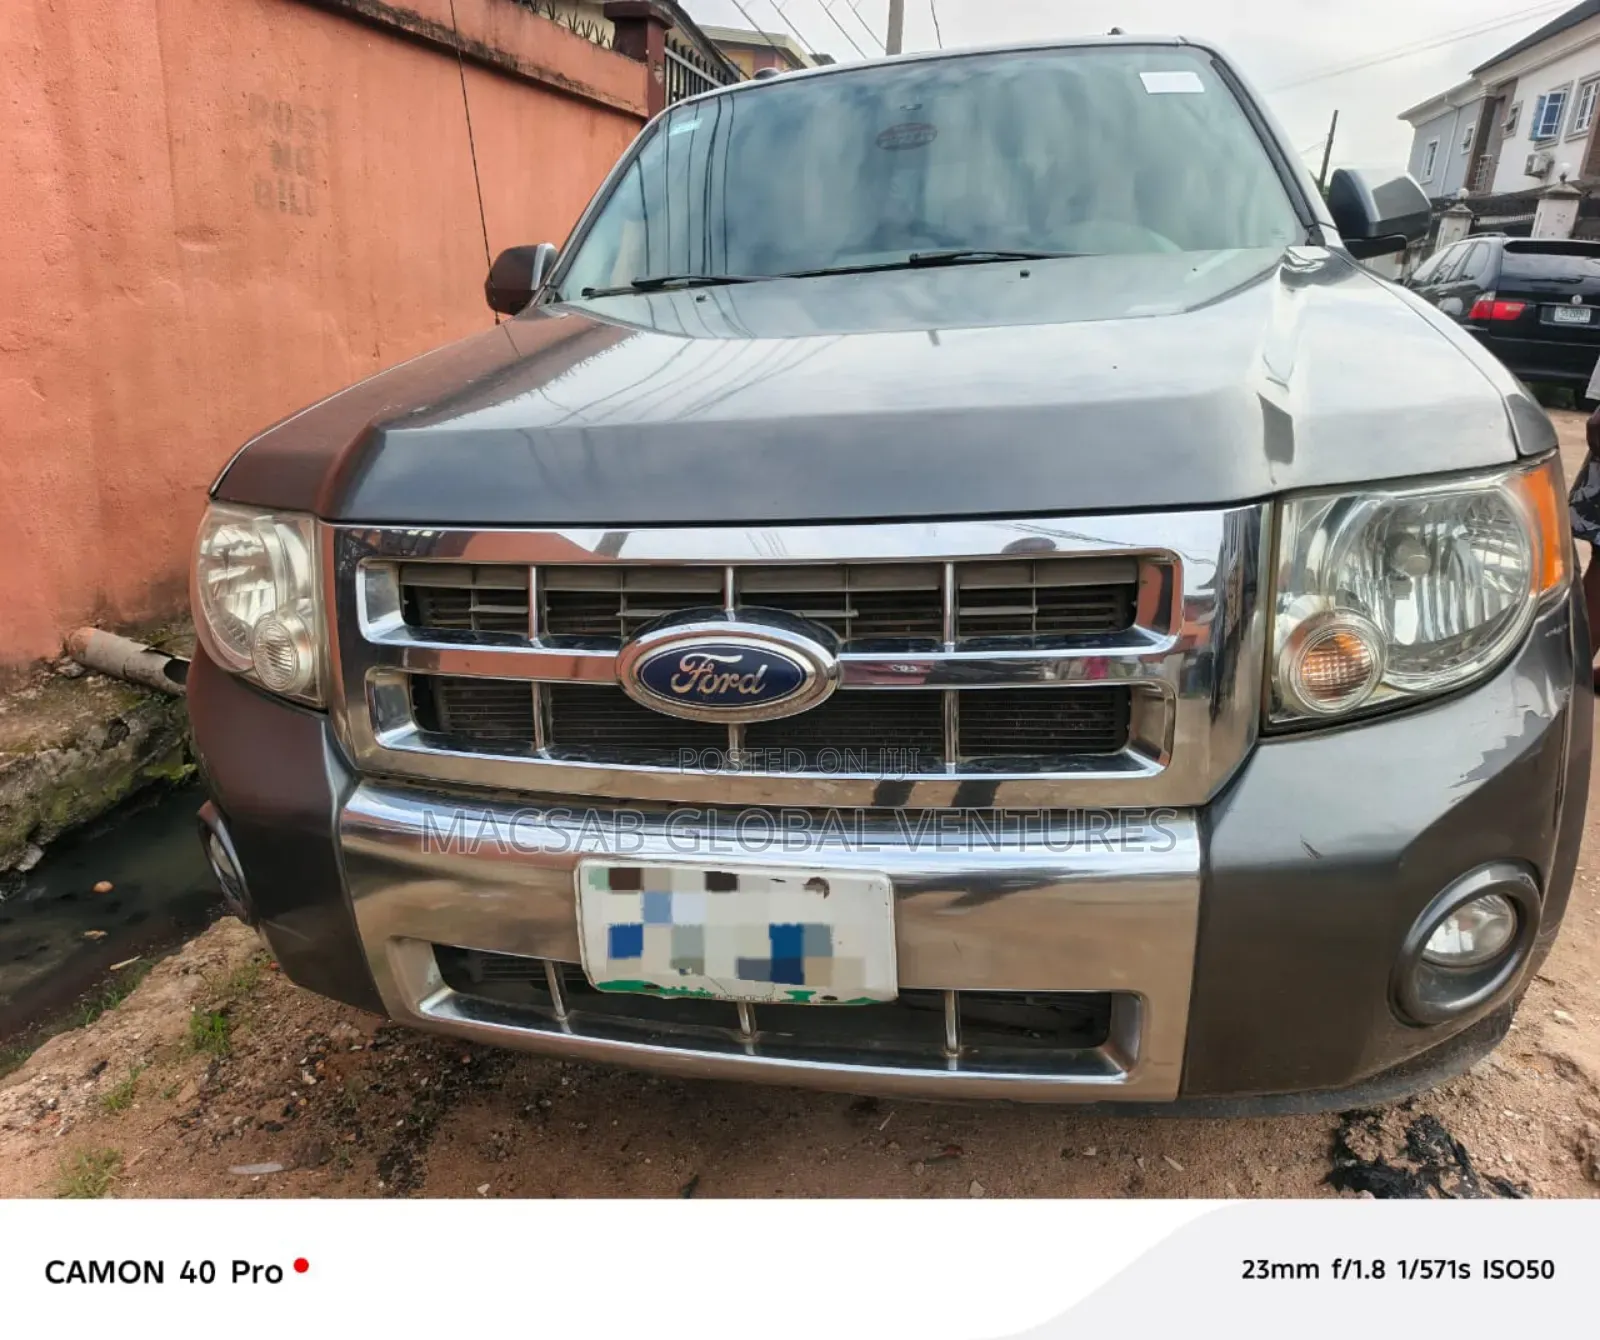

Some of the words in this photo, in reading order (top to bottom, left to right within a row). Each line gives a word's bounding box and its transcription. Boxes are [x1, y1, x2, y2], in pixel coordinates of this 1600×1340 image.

[248, 93, 335, 144] POST
[269, 139, 317, 178] NO
[670, 652, 768, 695] Ford
